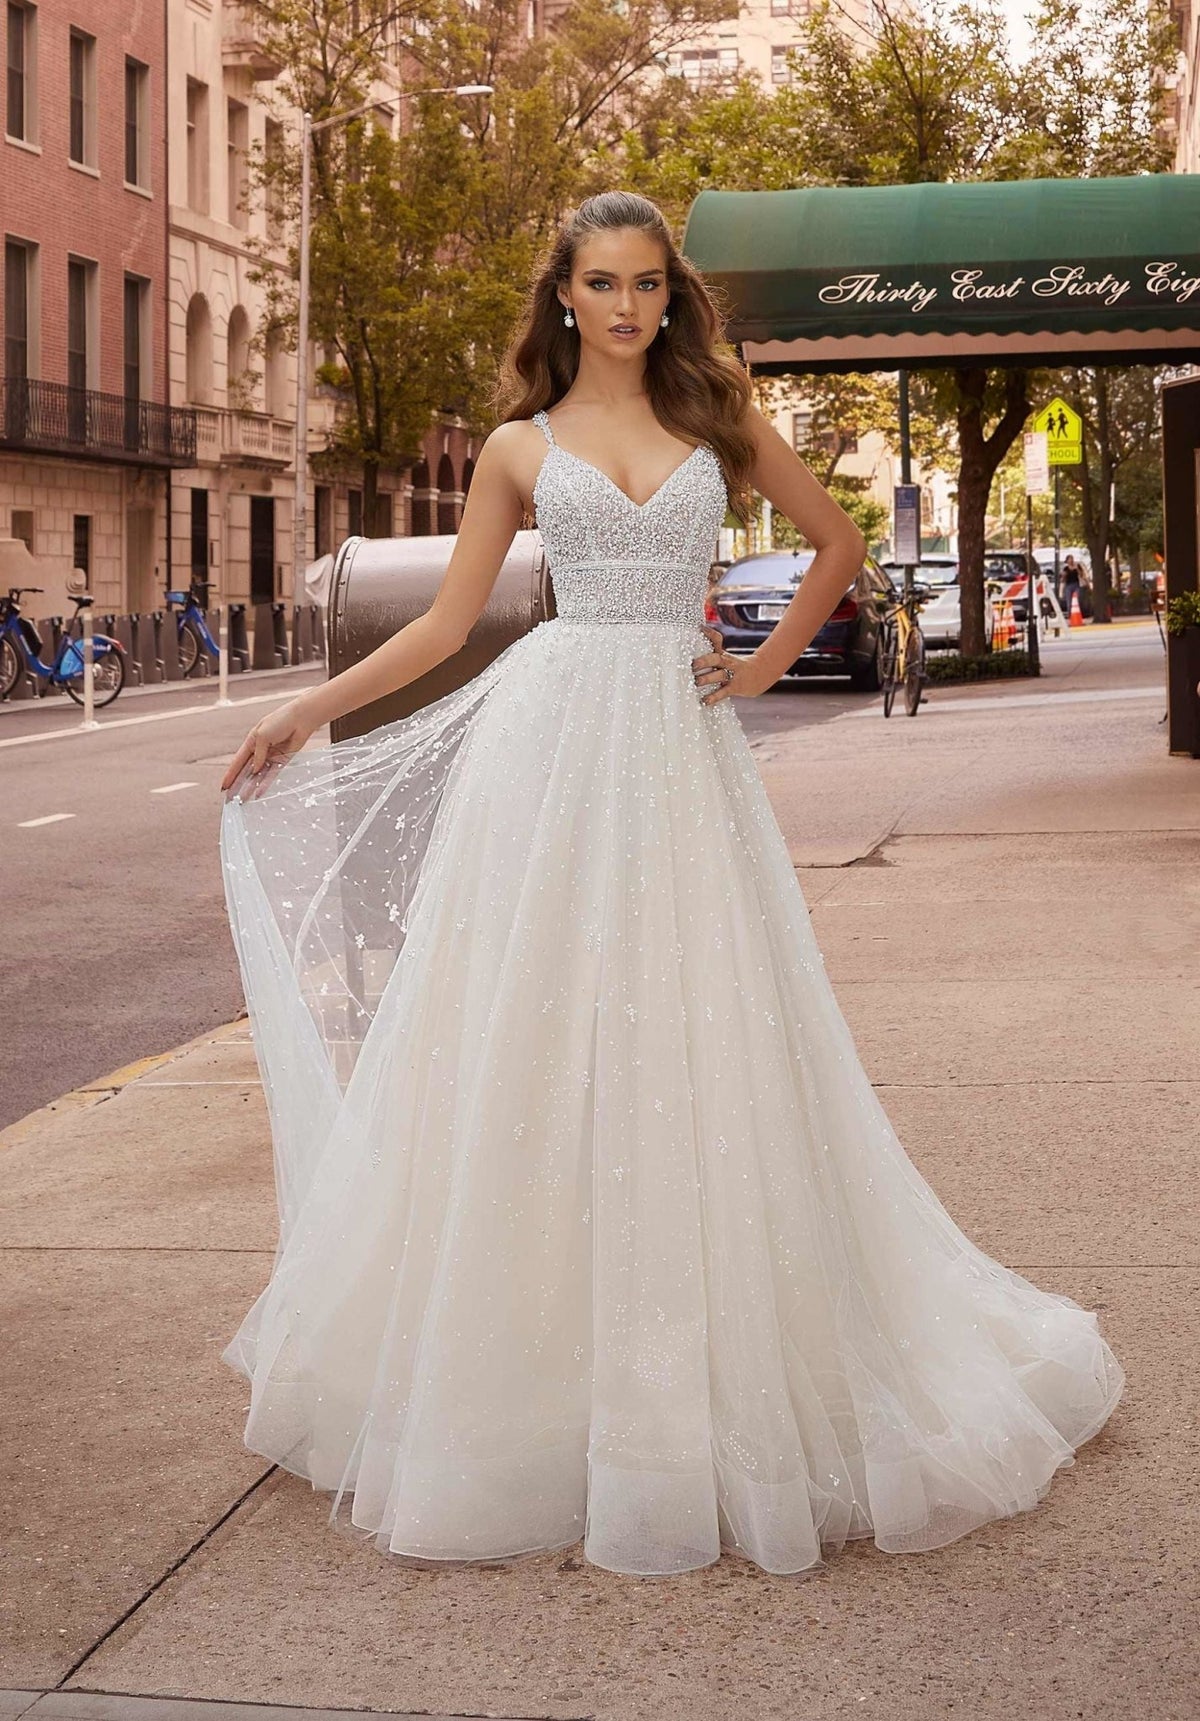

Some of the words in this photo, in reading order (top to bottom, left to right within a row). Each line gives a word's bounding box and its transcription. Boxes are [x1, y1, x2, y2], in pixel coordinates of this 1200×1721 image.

[818, 273, 938, 313] Thirty
[951, 269, 1026, 302] East
[1031, 265, 1131, 306] Sixty
[1049, 448, 1078, 458] HOOL
